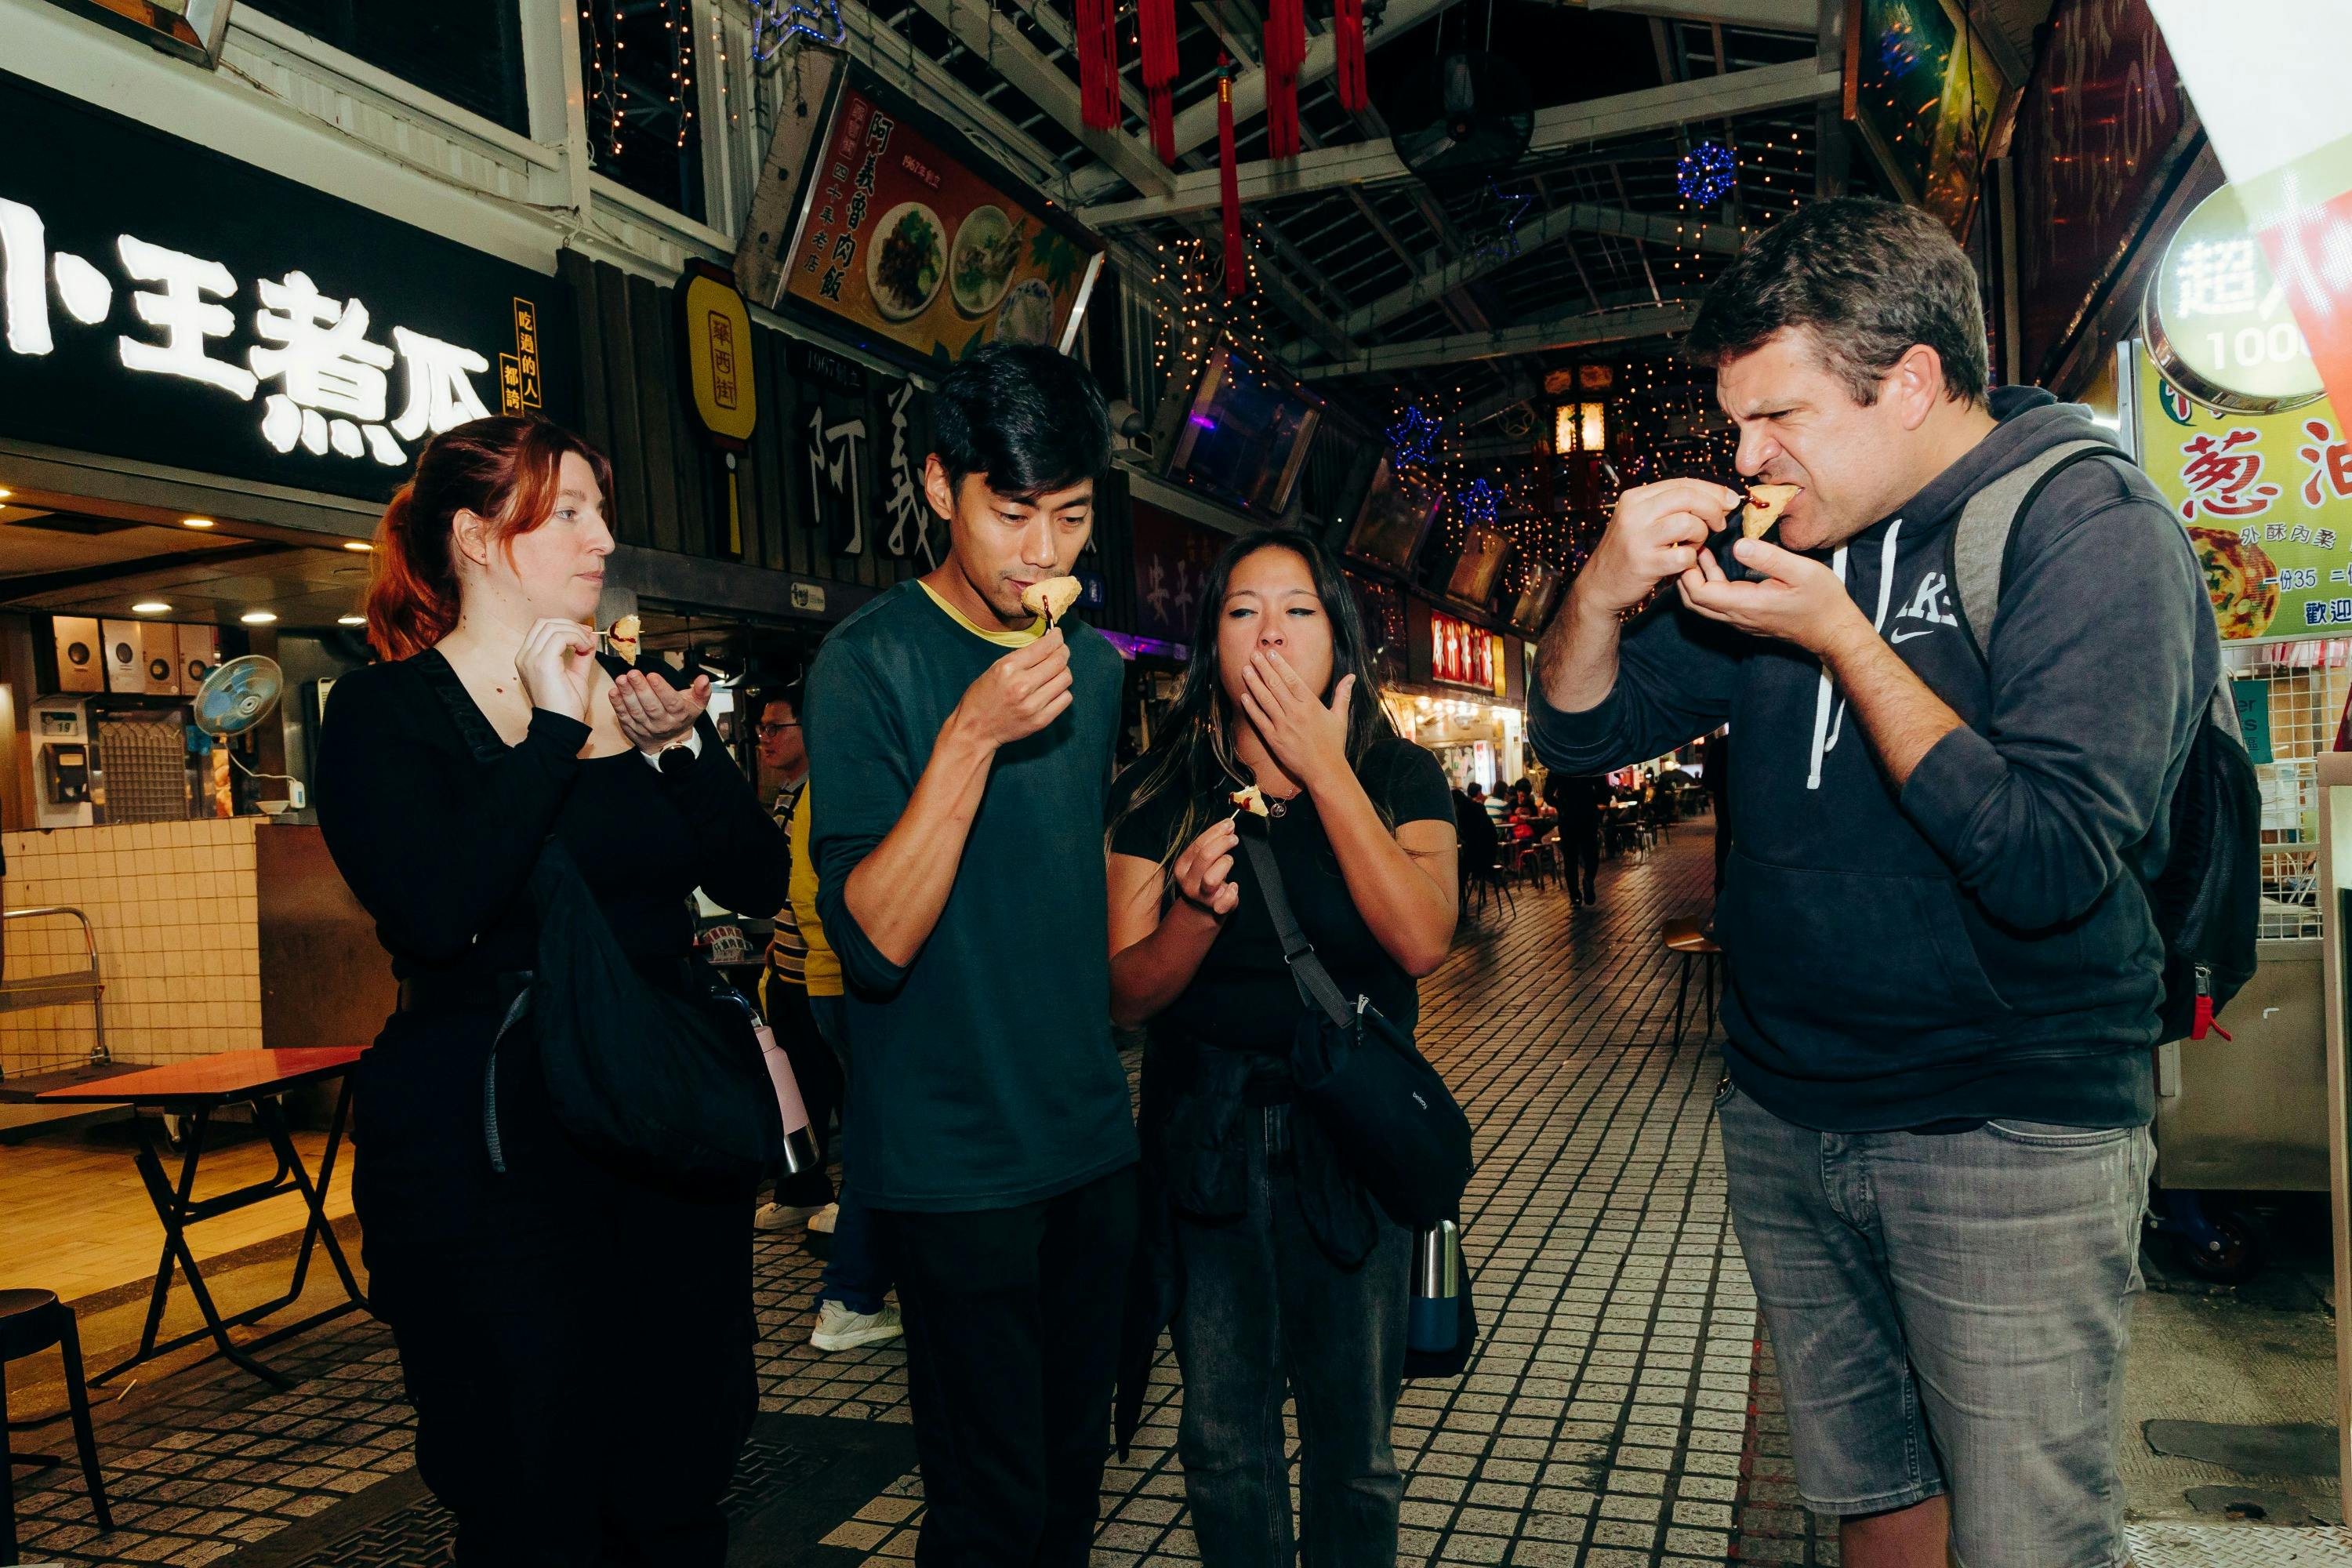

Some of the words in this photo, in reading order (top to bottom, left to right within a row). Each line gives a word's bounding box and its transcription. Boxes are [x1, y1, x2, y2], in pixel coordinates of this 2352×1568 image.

[518, 310, 539, 398] 吃過的人
[713, 319, 736, 405] 華西街
[2263, 568, 2317, 591] 一份35
